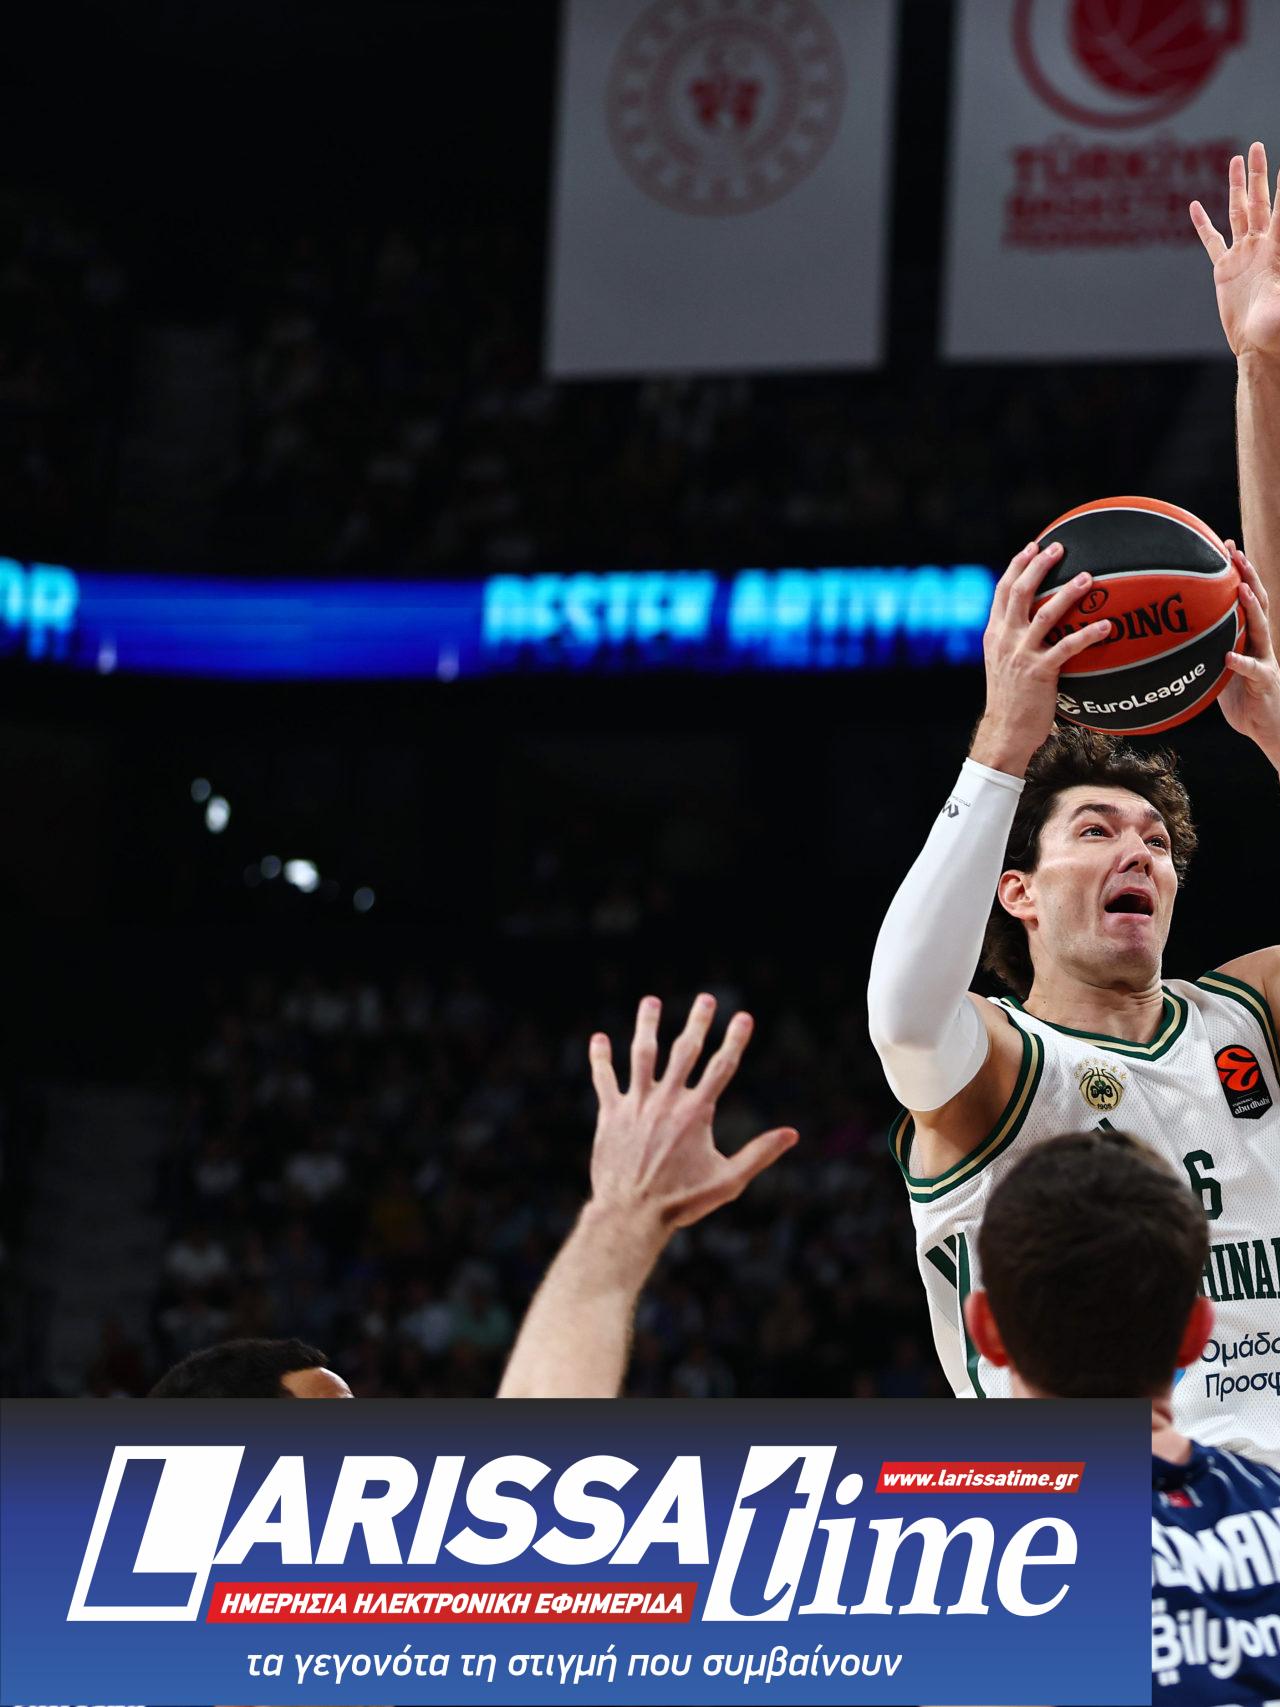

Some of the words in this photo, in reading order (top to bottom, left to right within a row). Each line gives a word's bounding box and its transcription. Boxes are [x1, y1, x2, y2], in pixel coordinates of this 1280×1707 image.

[1044, 592, 1190, 648] PDING
[1083, 661, 1207, 715] EuroLeague
[1183, 1150, 1223, 1221] 6
